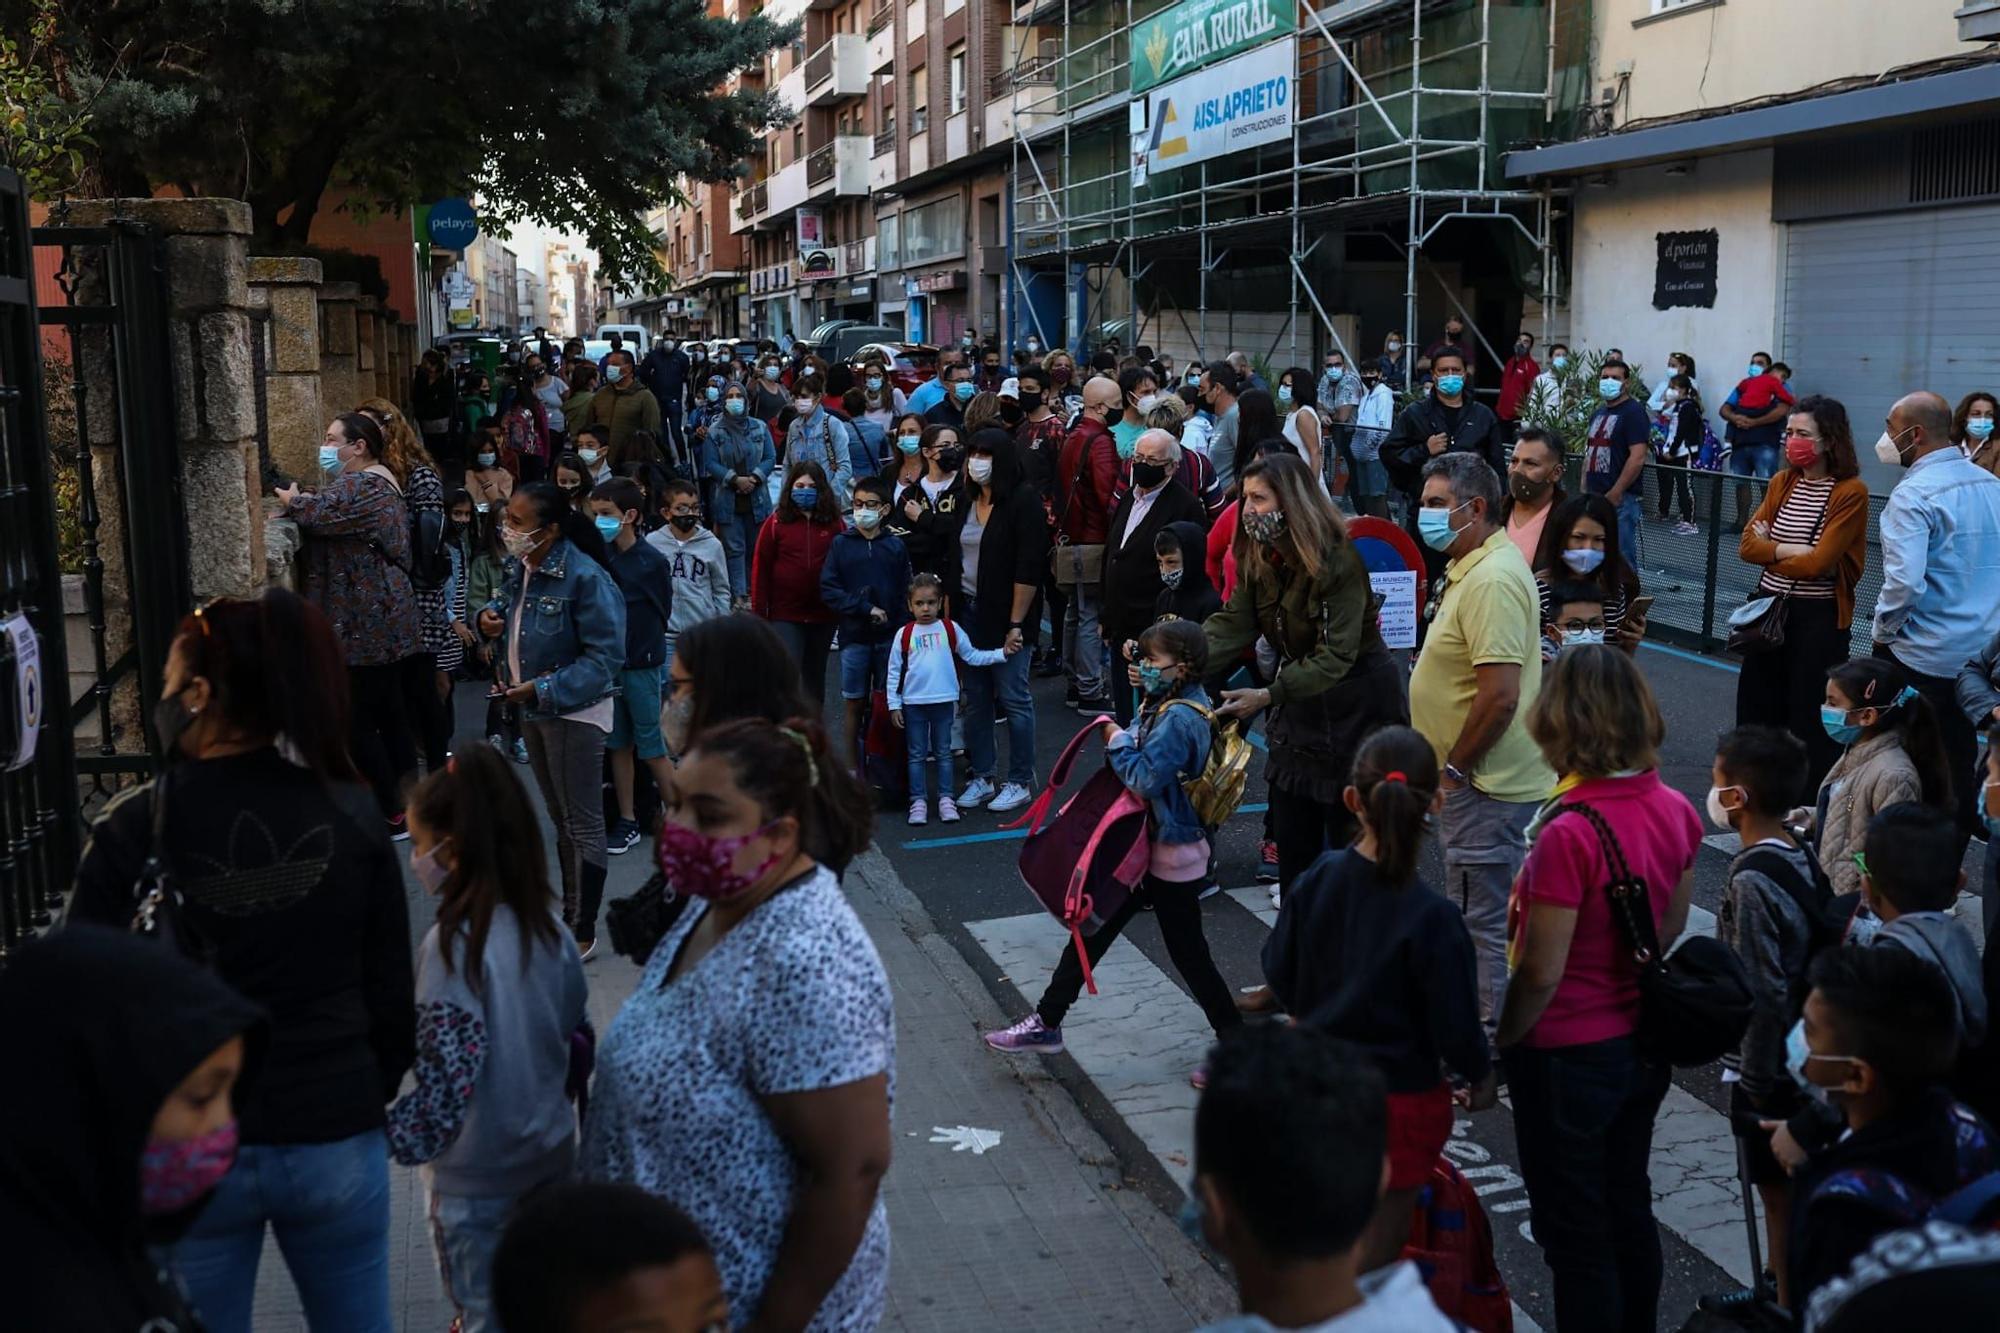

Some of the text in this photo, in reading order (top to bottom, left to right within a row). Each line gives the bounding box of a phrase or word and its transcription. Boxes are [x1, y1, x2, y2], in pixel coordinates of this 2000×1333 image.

[1172, 19, 1206, 68] CAJA
[1210, 0, 1276, 50] RURAL
[1193, 76, 1287, 131] AISLAPRIETO
[1231, 114, 1287, 138] CONSTRUCCIONES
[431, 216, 475, 231] pelayo
[665, 552, 705, 582] AP
